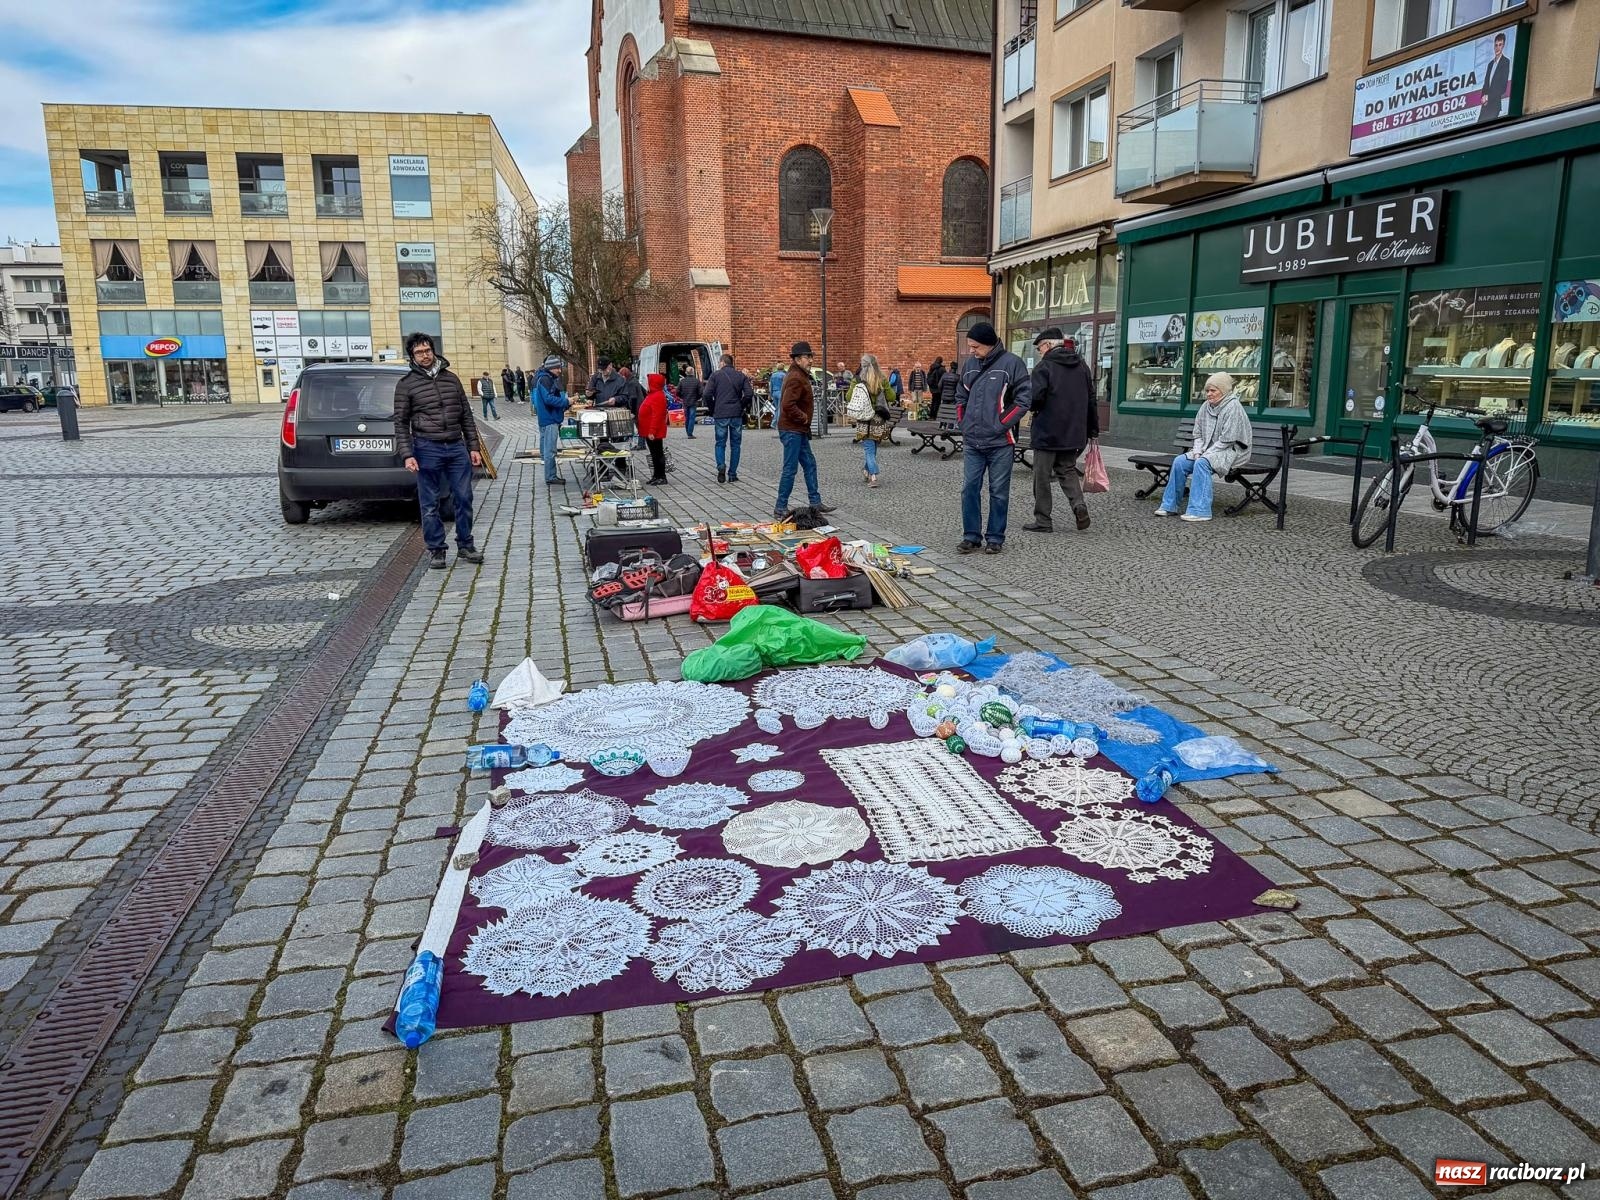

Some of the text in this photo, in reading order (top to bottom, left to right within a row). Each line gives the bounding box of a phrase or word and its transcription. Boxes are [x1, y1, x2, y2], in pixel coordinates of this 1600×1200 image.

[1395, 63, 1443, 91] LOKAL
[1365, 71, 1477, 117] DO WYNAJĘCIA
[1371, 95, 1467, 133] tel. 572 200 604
[1243, 196, 1436, 259] JUBILER
[1356, 239, 1432, 264] M. Karpisz
[1276, 258, 1307, 273] 1989
[1478, 294, 1508, 302] NAPRAWA
[1249, 311, 1258, 323] do
[21, 348, 46, 357] DANCE
[149, 343, 179, 351] PEPCO
[341, 439, 391, 449] SG 9809M
